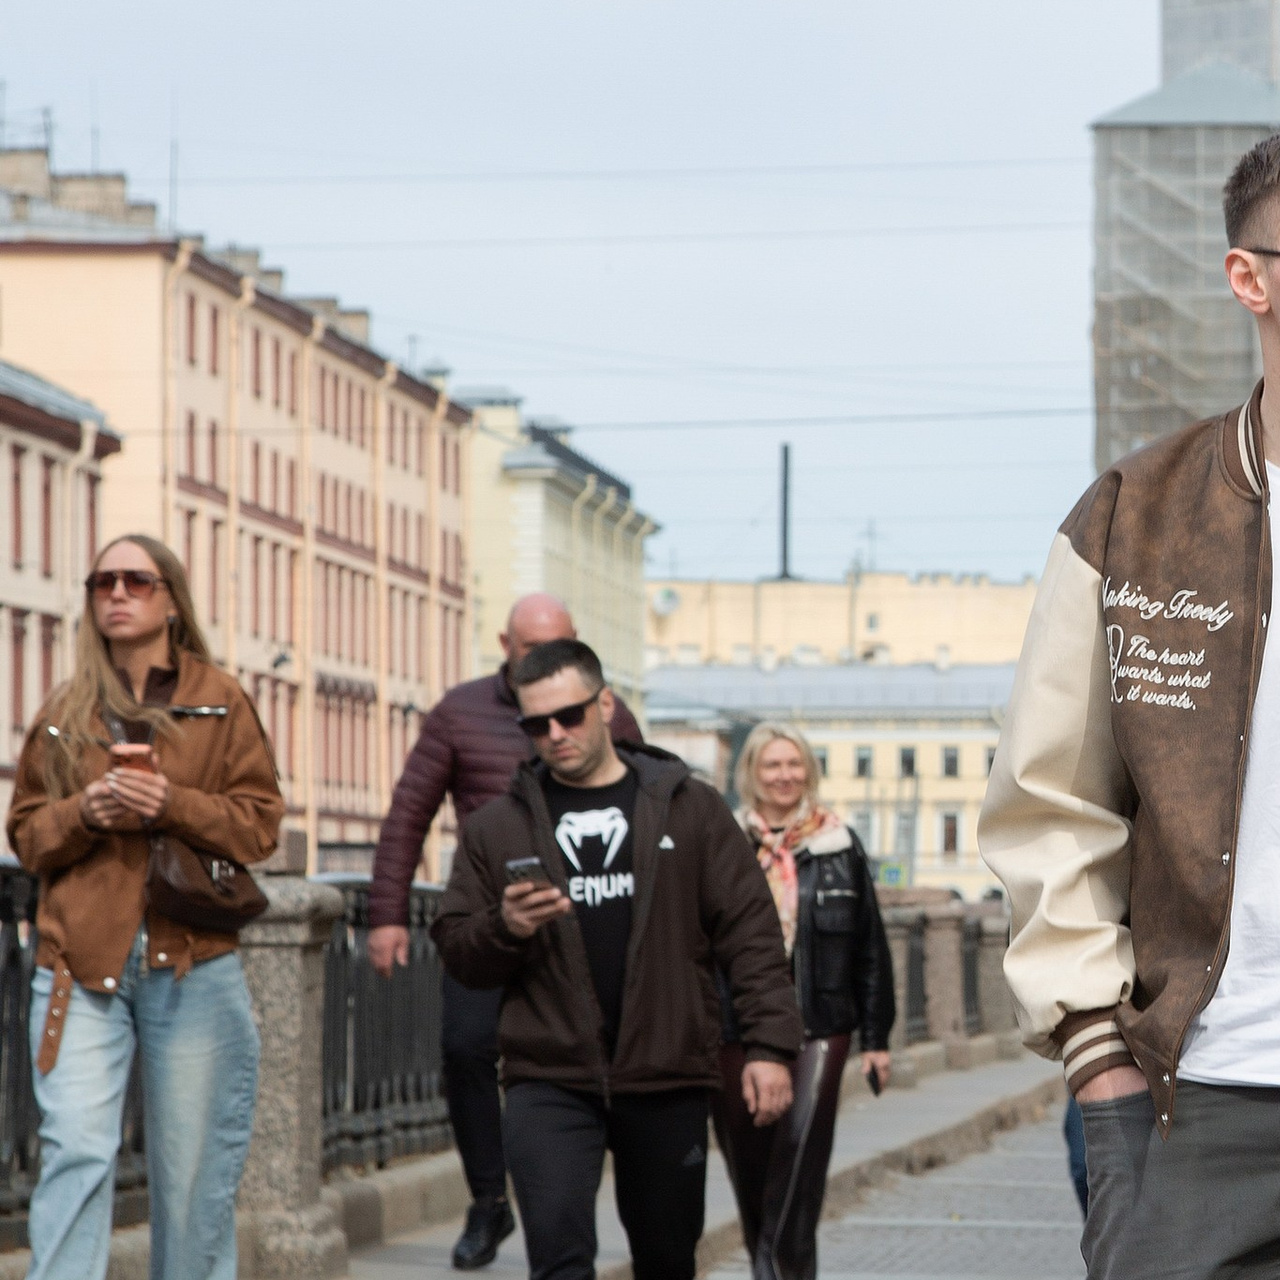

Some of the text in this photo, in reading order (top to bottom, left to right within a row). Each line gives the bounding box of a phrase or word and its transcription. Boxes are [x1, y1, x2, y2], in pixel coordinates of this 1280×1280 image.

[1127, 634, 1206, 666] The heart
[1118, 665, 1212, 689] wants what
[1127, 684, 1141, 702] it
[569, 872, 634, 907] ENUM
